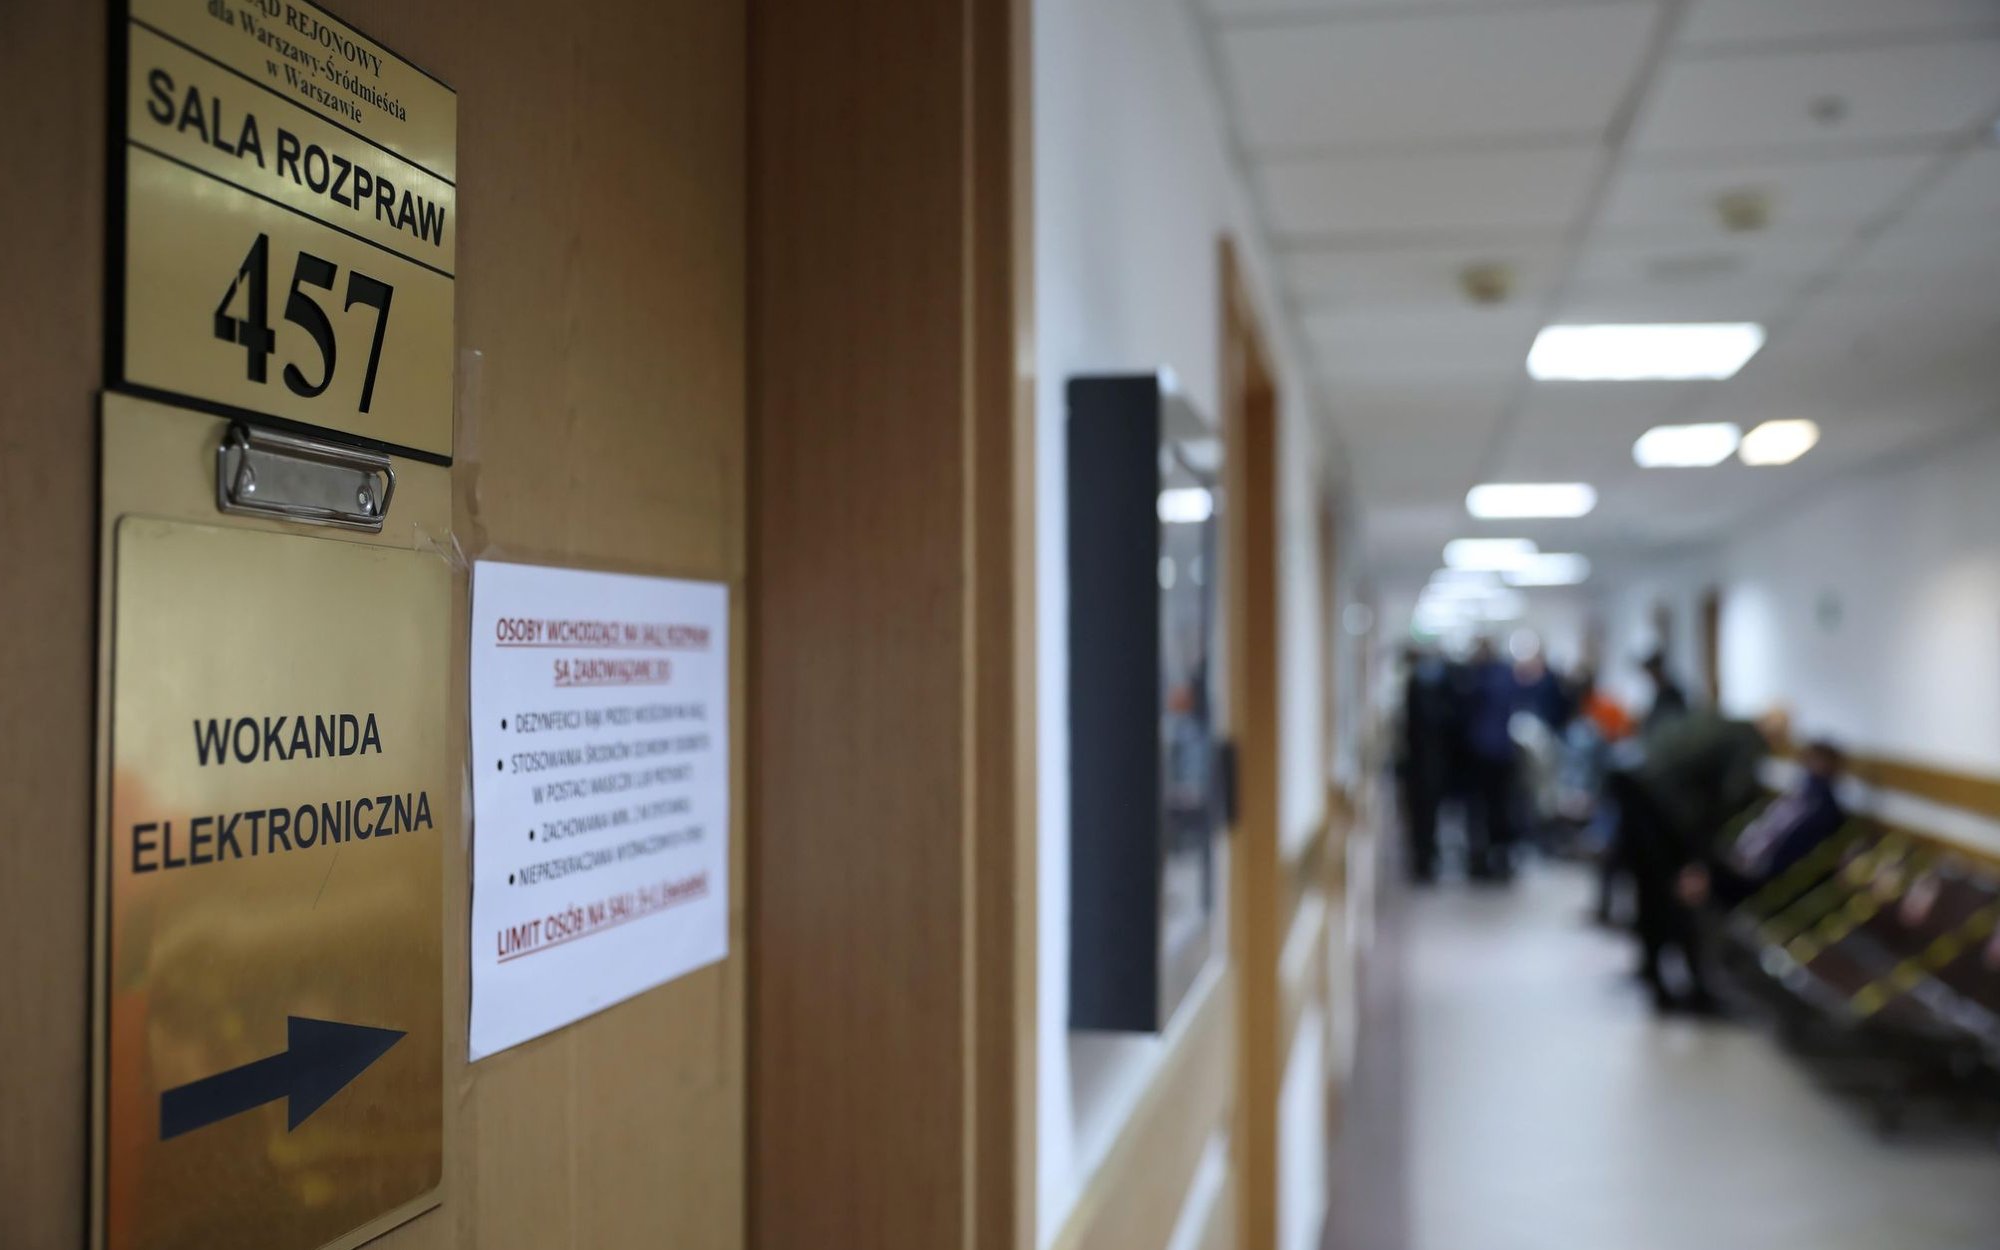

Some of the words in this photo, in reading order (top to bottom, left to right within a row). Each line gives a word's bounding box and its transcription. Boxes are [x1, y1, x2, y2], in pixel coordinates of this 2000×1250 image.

[207, 0, 234, 26] dla
[239, 10, 407, 122] Warszawy-Śródmieścia
[244, 0, 281, 19] ĄD
[286, 4, 383, 79] REJONOWY
[266, 59, 279, 78] w
[284, 63, 363, 124] Warszawie
[147, 67, 265, 169] SALA
[277, 127, 445, 247] ROZPRAW
[214, 233, 394, 413] 457
[496, 618, 544, 643] OSOBY
[194, 713, 382, 766] WOKANDA
[132, 791, 433, 874] ELEKTRONICZNA
[497, 918, 543, 957] LIMIT
[545, 900, 585, 942] OSÓB
